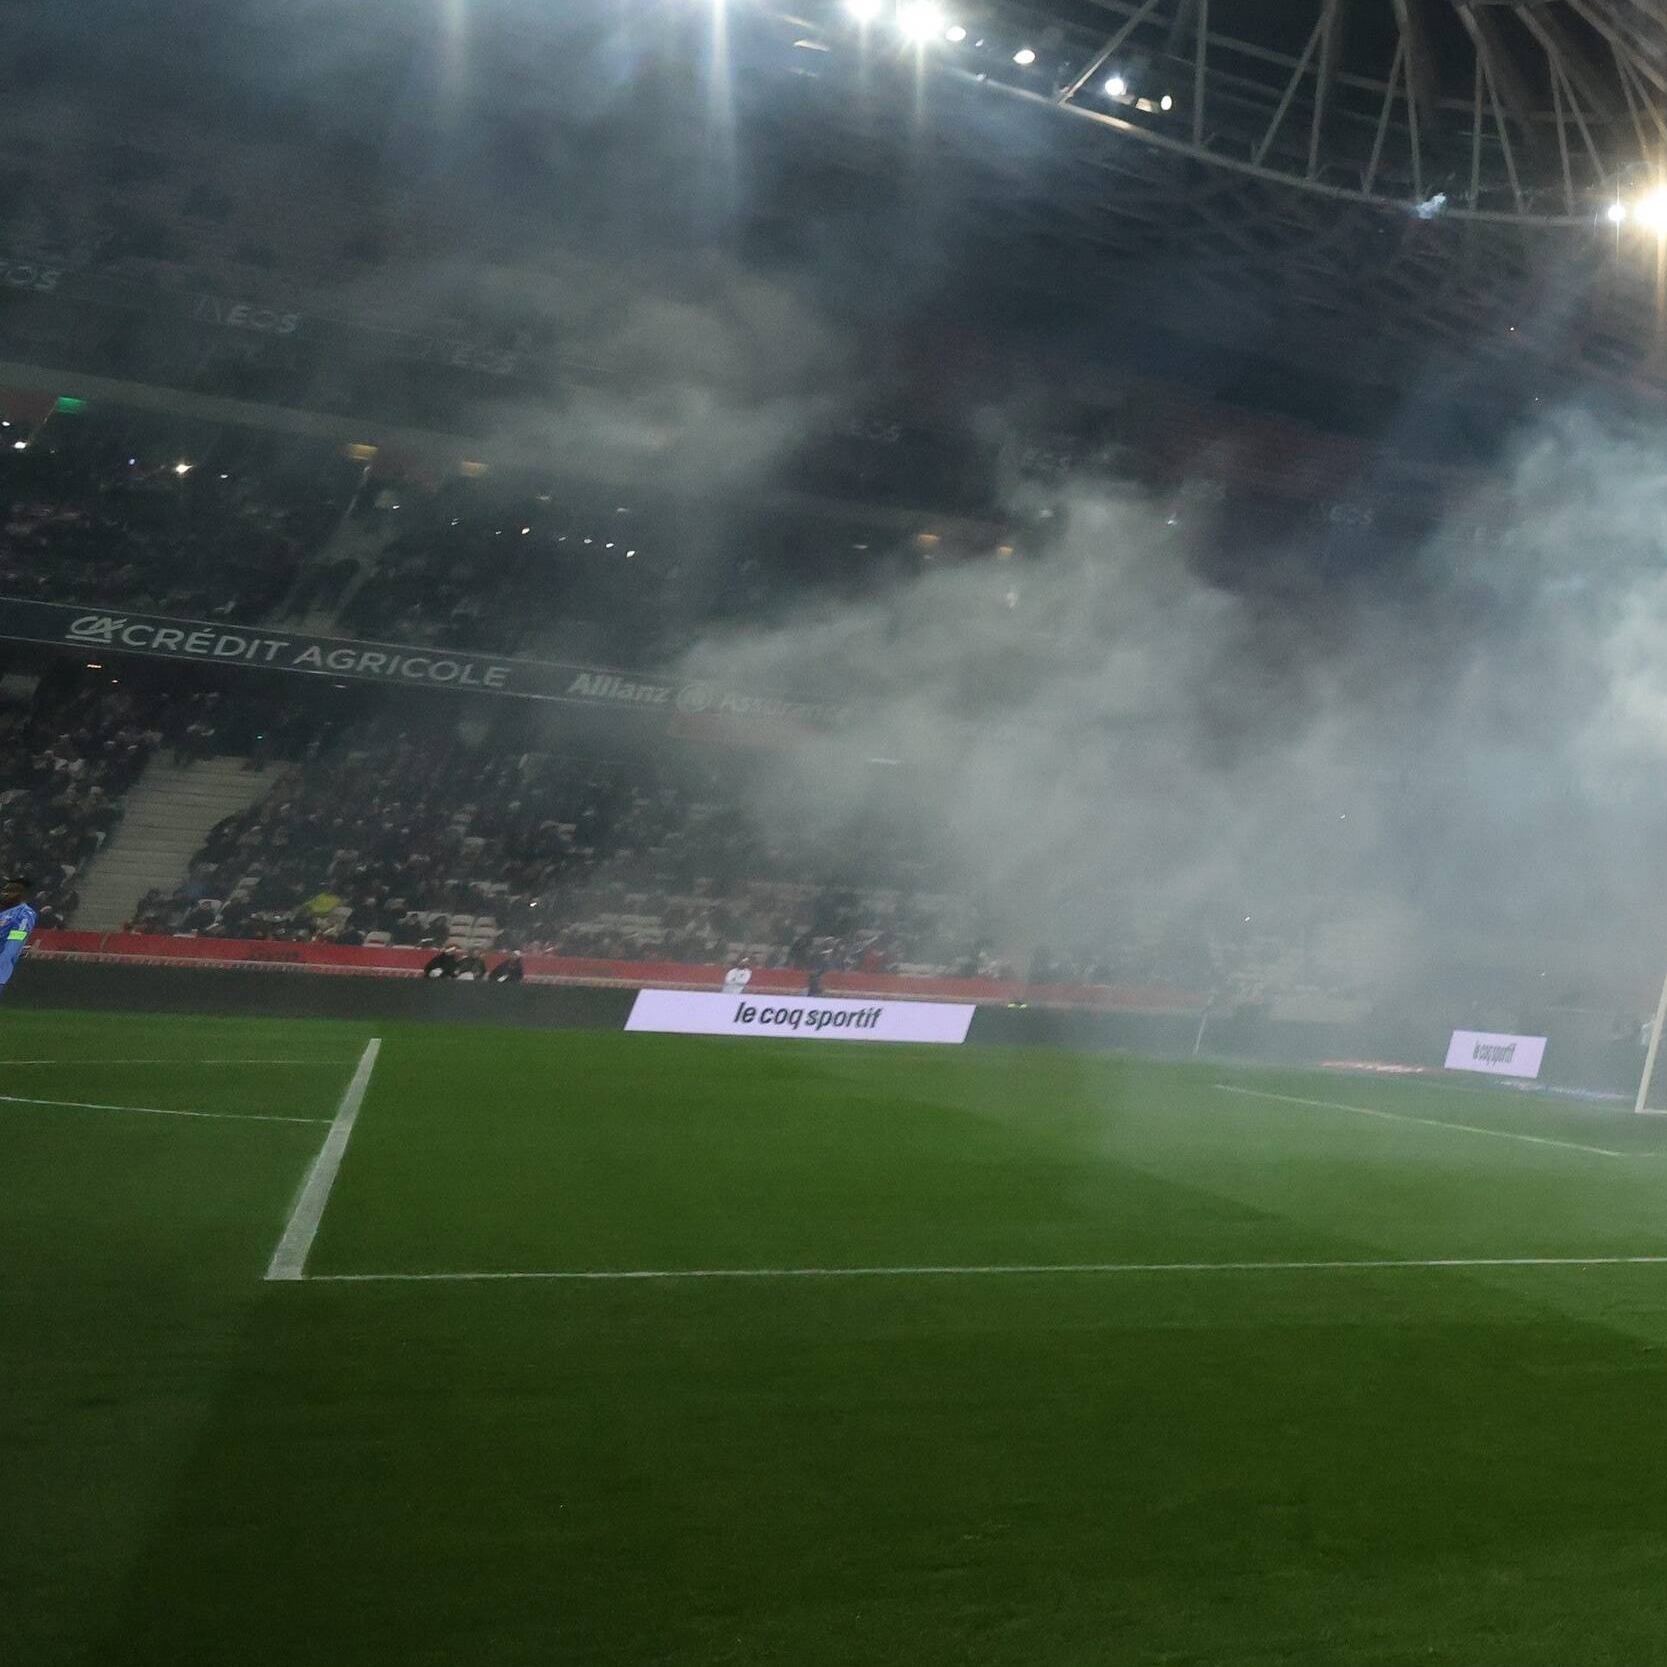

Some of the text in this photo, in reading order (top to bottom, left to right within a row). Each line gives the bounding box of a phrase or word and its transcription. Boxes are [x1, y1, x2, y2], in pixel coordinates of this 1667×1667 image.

[120, 624, 291, 662] CRÉDIT
[292, 644, 512, 688] AGRICOLE
[567, 672, 671, 704] Allianz
[734, 1001, 883, 1031] le coq sportif
